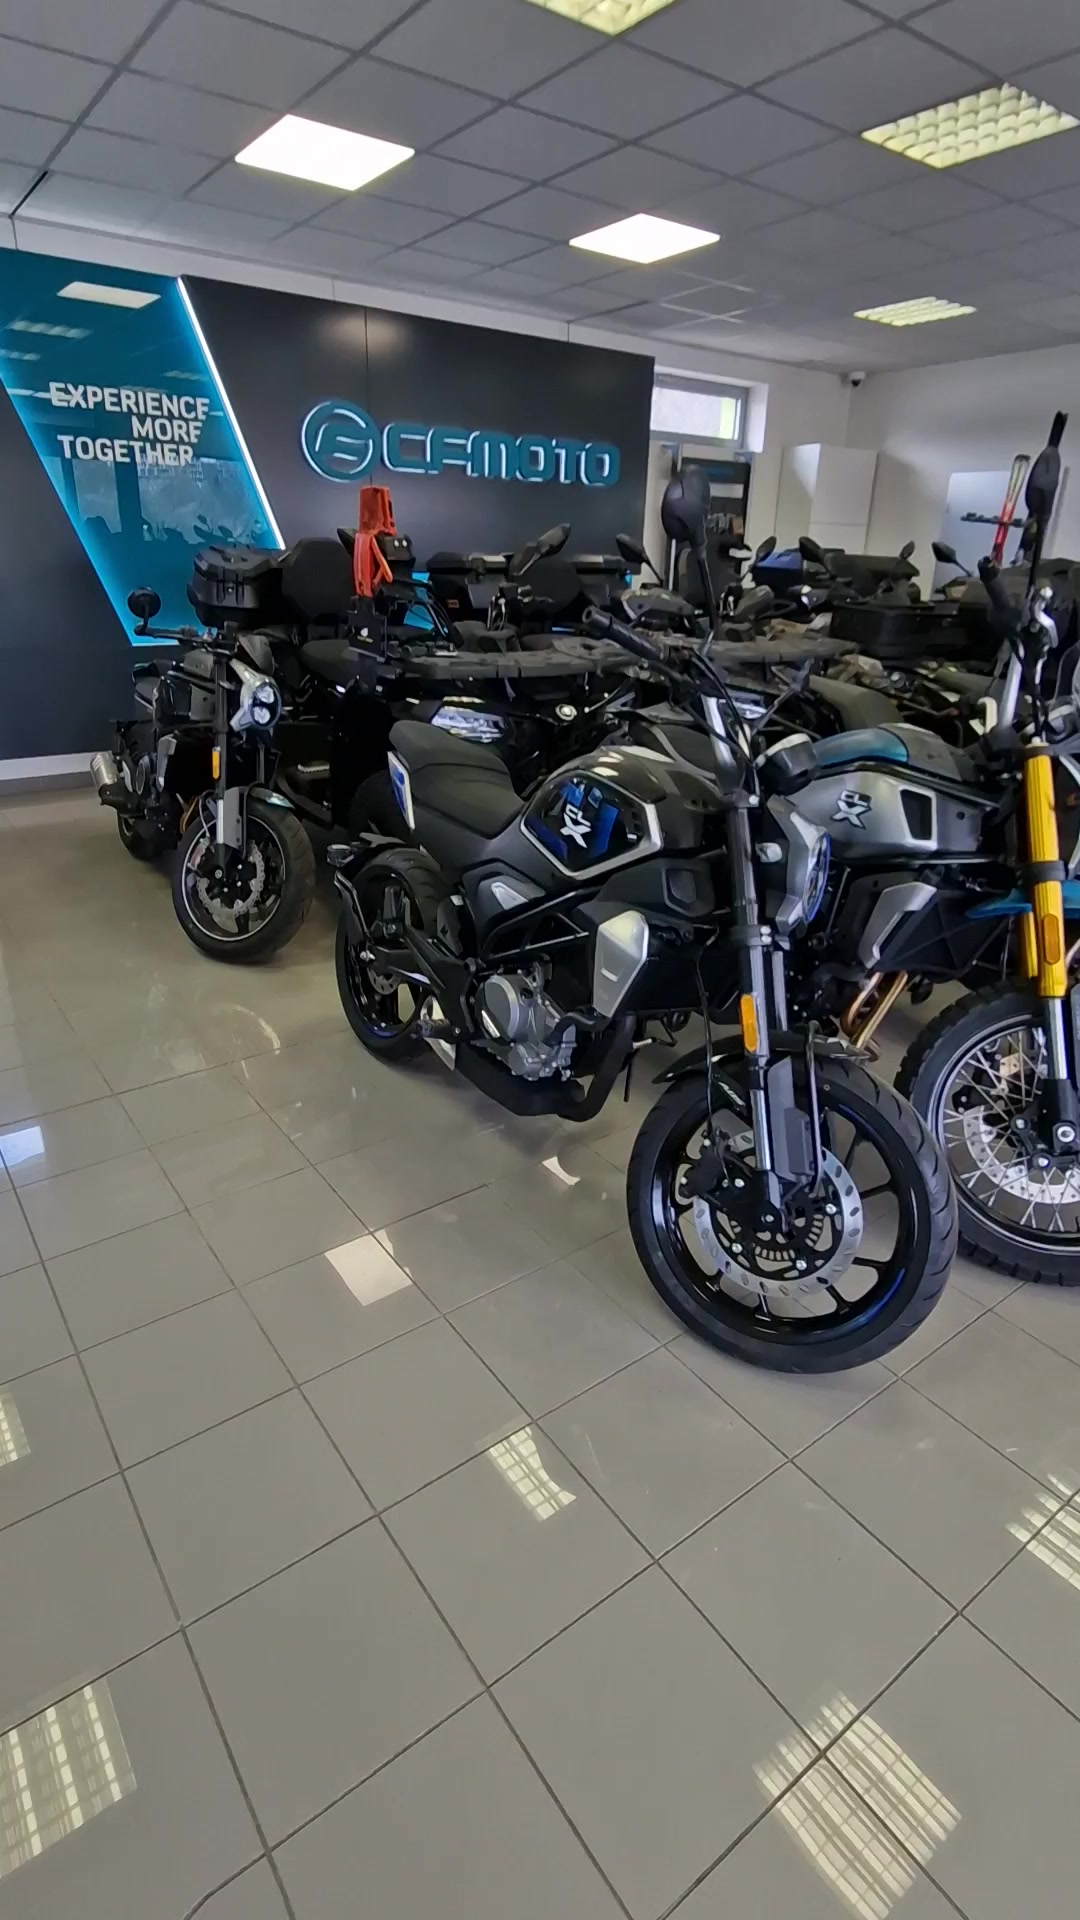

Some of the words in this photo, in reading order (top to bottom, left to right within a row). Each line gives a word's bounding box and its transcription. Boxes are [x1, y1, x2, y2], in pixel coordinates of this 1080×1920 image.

[49, 382, 209, 421] EXPERIENCE
[131, 416, 202, 443] MORE
[57, 434, 193, 466] TOGETHER
[382, 422, 620, 486] CFMOTO
